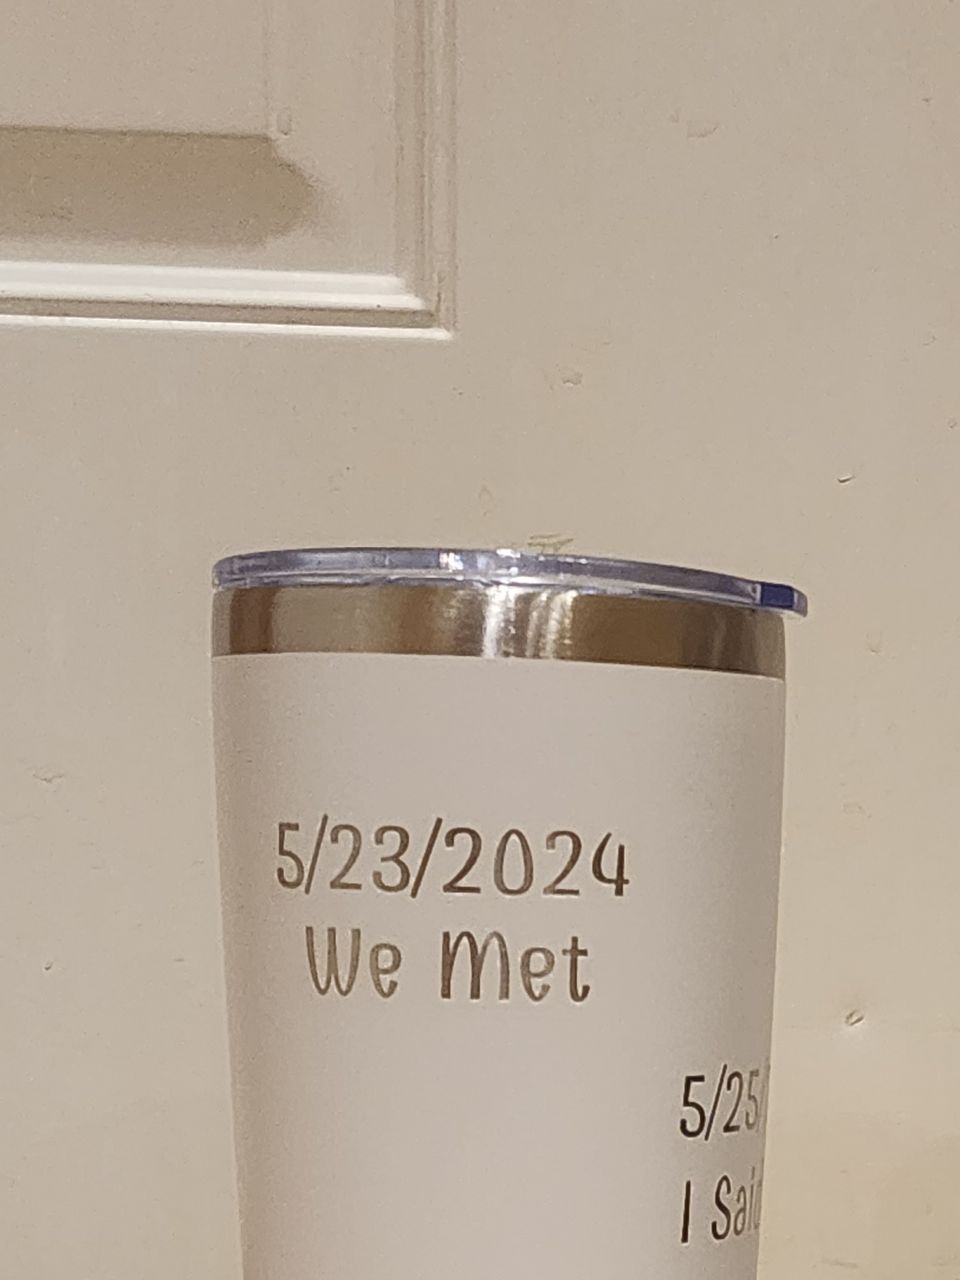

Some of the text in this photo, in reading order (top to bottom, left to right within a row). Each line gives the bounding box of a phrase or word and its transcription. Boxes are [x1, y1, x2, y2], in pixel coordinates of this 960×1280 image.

[276, 813, 630, 898] 5/23/2024
[305, 925, 590, 1002] We Met
[681, 1180, 691, 1243] I
